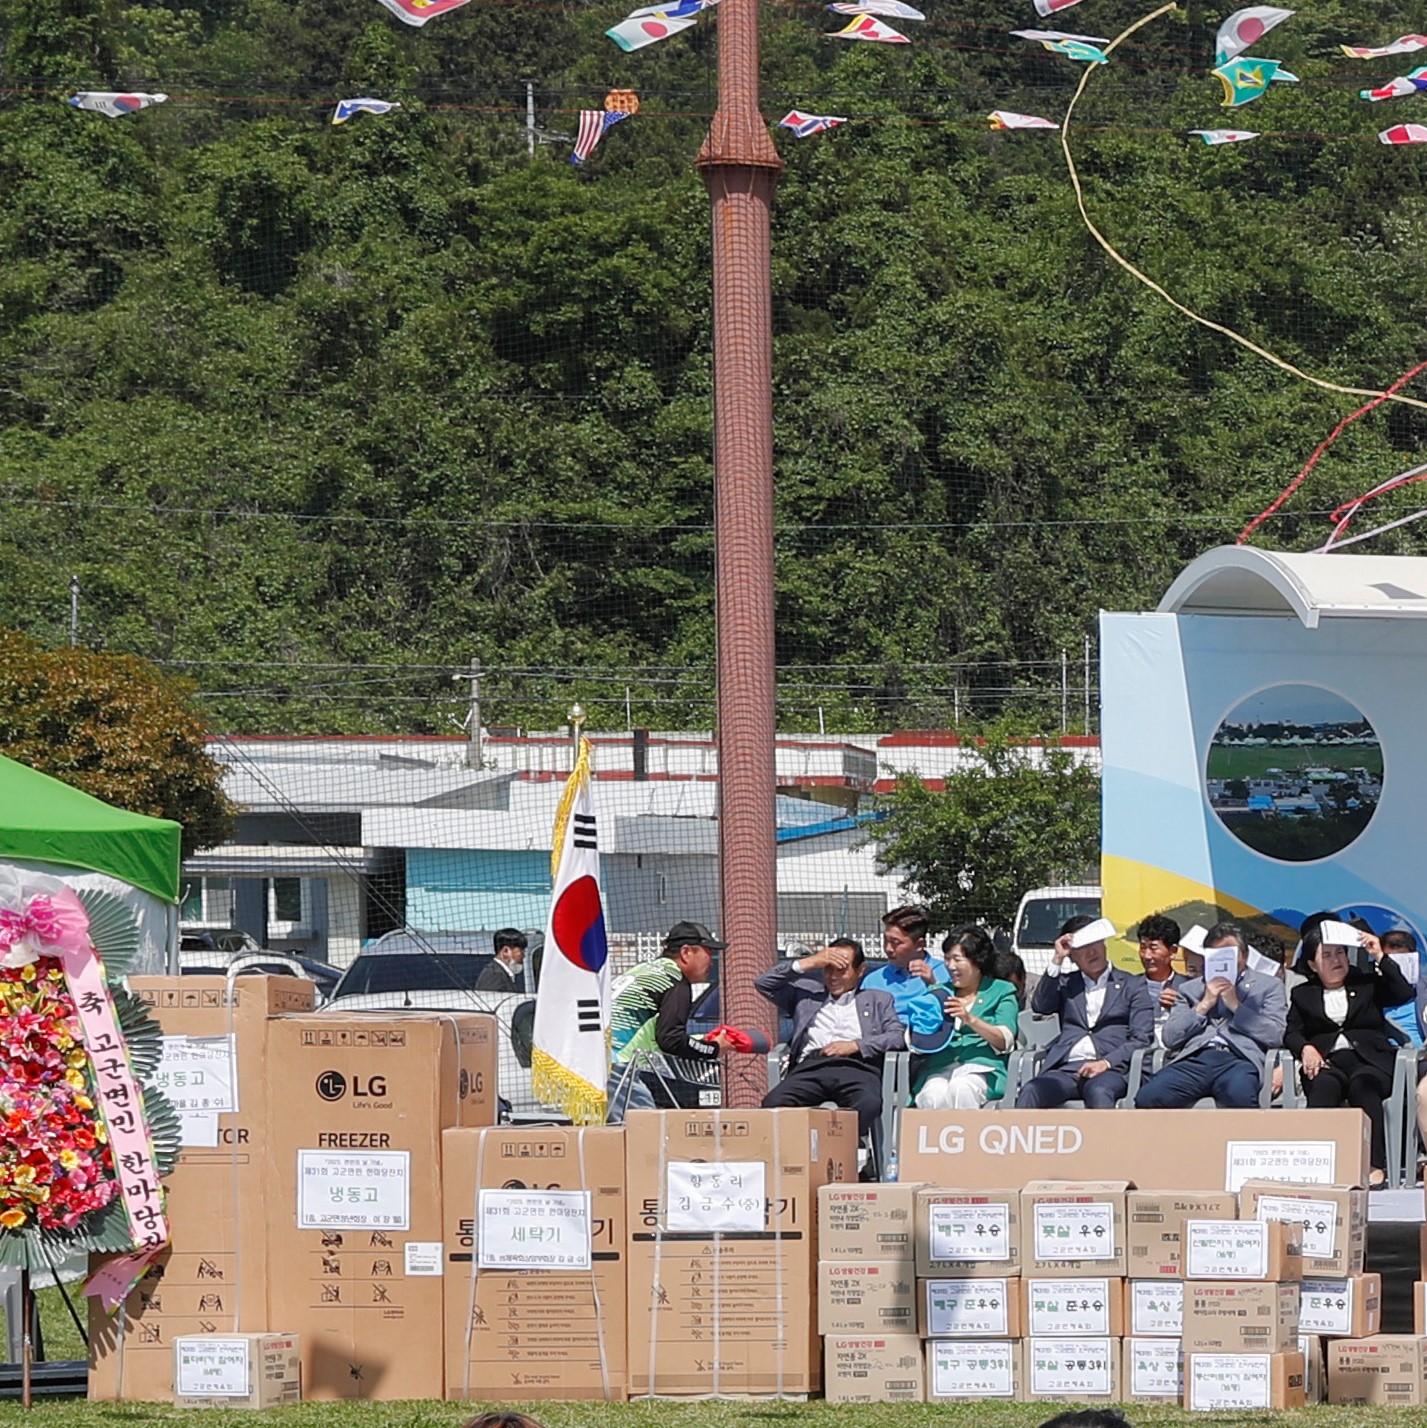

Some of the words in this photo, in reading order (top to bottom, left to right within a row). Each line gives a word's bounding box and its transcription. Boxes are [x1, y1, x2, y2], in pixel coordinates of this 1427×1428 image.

[79, 991, 105, 1016] 축
[91, 1034, 135, 1134] 고군면민
[352, 1076, 387, 1097] LG
[373, 1101, 393, 1110] Good
[318, 1133, 390, 1148] FREEZER
[917, 1125, 966, 1154] LG
[978, 1124, 1083, 1156] QNED
[730, 1175, 743, 1188] 리
[329, 1186, 379, 1202] 냉동고
[511, 1226, 561, 1243] 세탁기
